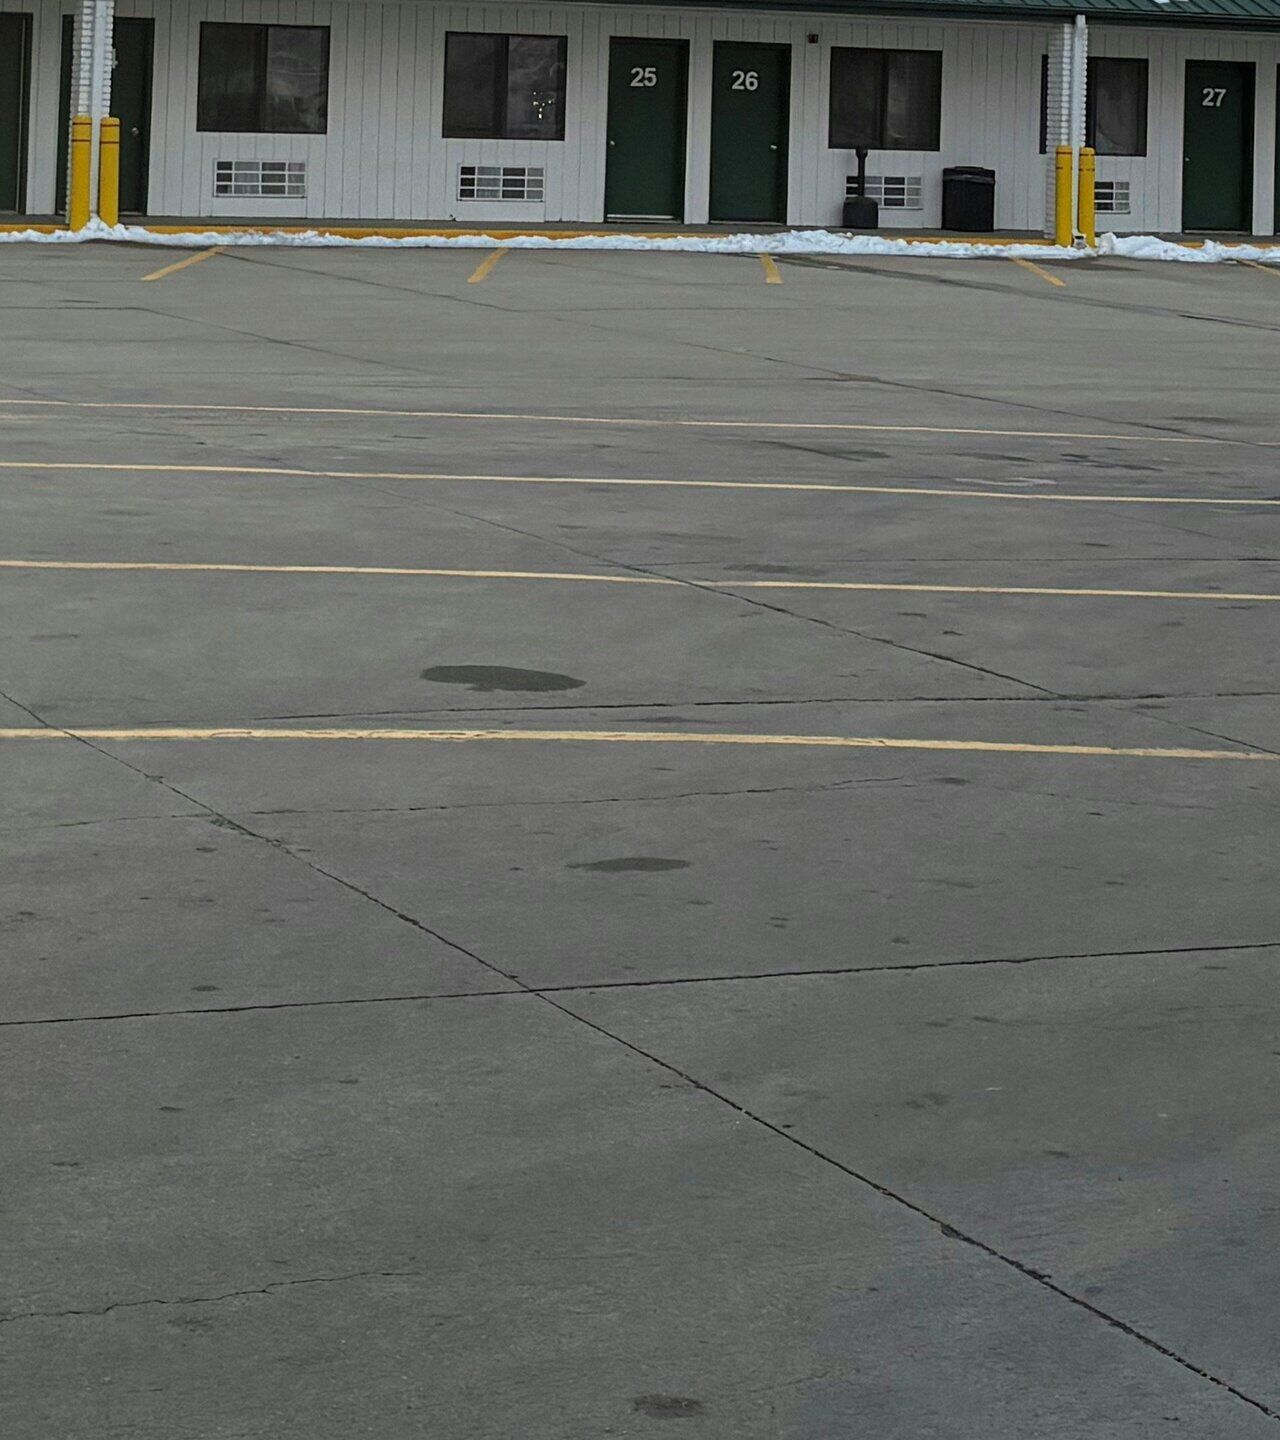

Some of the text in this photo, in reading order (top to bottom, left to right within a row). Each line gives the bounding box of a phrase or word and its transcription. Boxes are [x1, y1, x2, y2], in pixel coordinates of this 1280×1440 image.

[630, 67, 657, 87] 25
[731, 70, 759, 91] 26
[1202, 87, 1227, 107] 27
